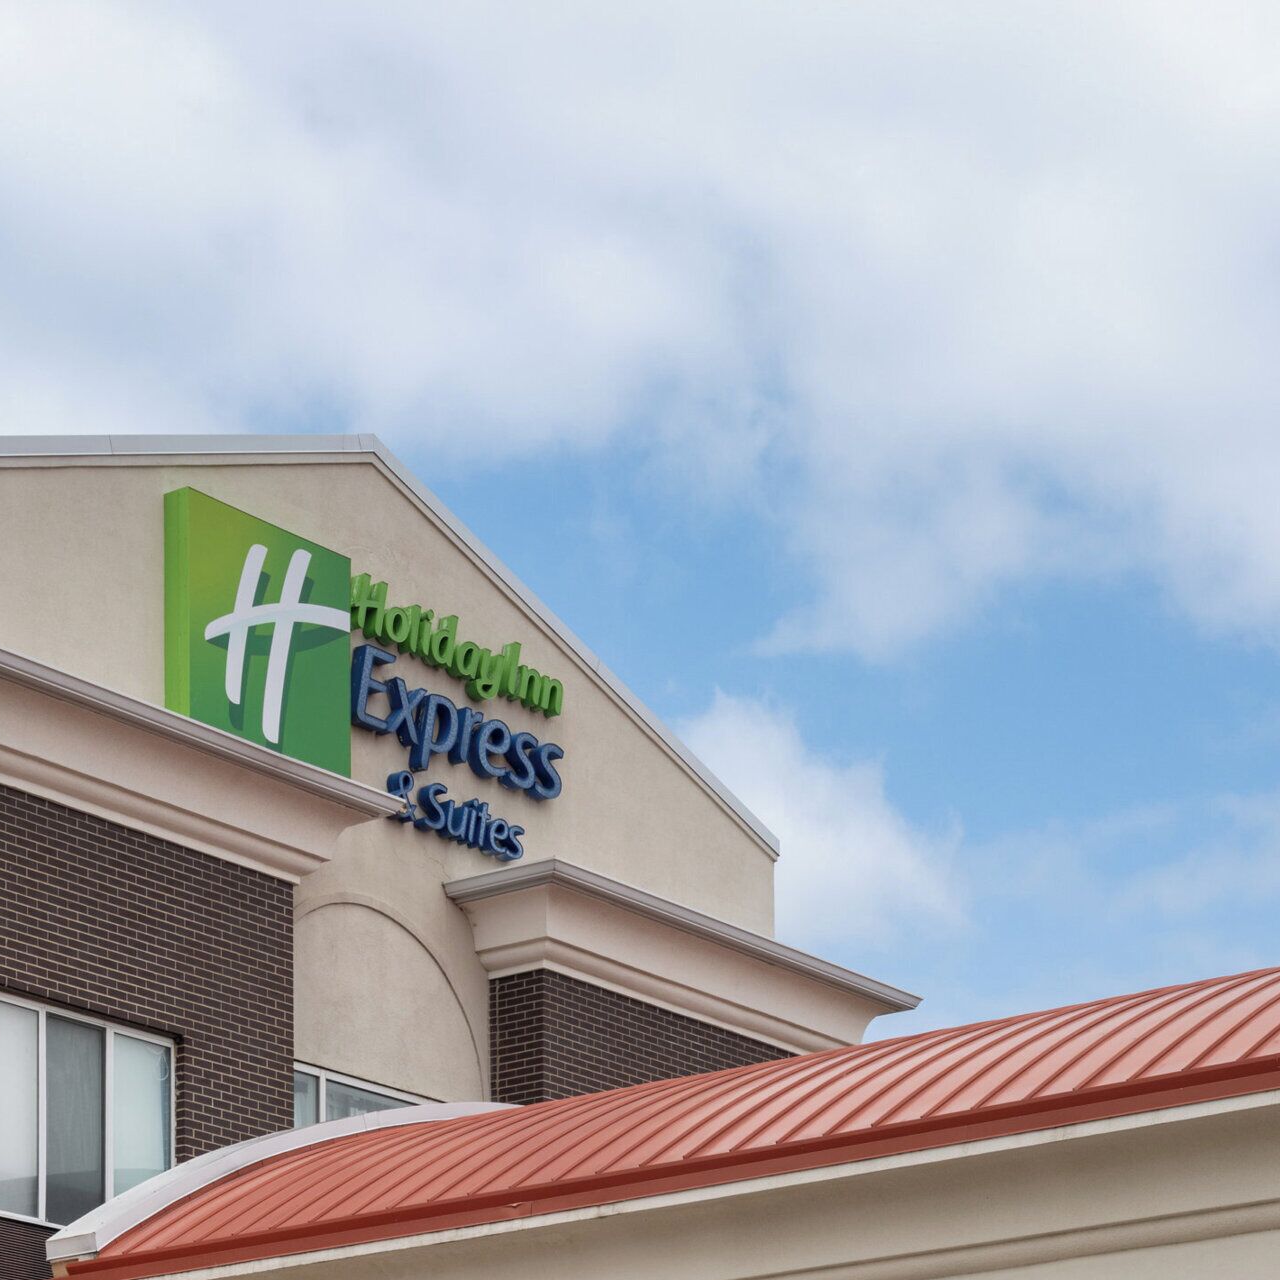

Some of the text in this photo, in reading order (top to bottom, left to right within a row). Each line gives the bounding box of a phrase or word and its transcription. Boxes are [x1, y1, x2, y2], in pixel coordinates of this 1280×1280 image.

[351, 573, 503, 700] Holiday
[351, 644, 564, 800] Express
[416, 783, 525, 861] Suites
